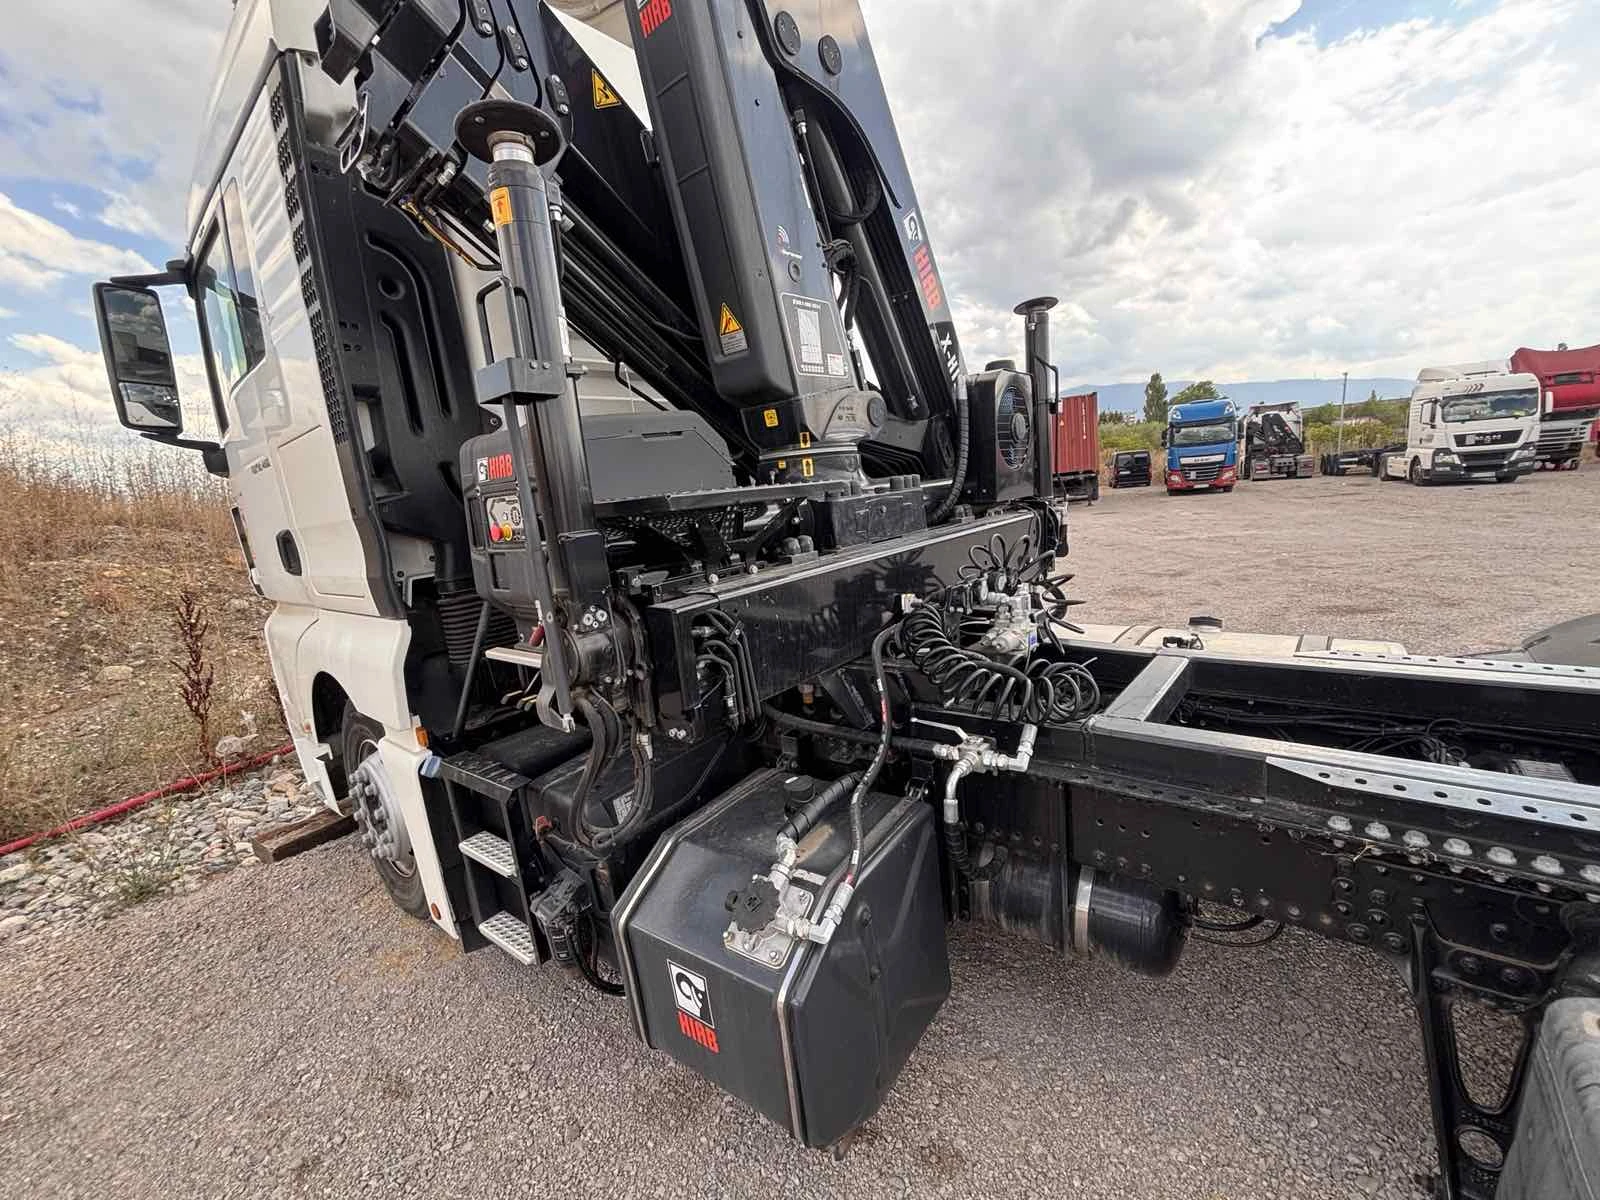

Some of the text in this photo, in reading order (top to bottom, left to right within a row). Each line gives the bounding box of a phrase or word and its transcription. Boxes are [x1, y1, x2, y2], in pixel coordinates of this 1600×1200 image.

[639, 0, 672, 39] HIAB
[912, 244, 942, 311] HIAB
[940, 331, 961, 391] X-HI
[488, 453, 514, 481] HIAB
[678, 1010, 719, 1053] HIAB
